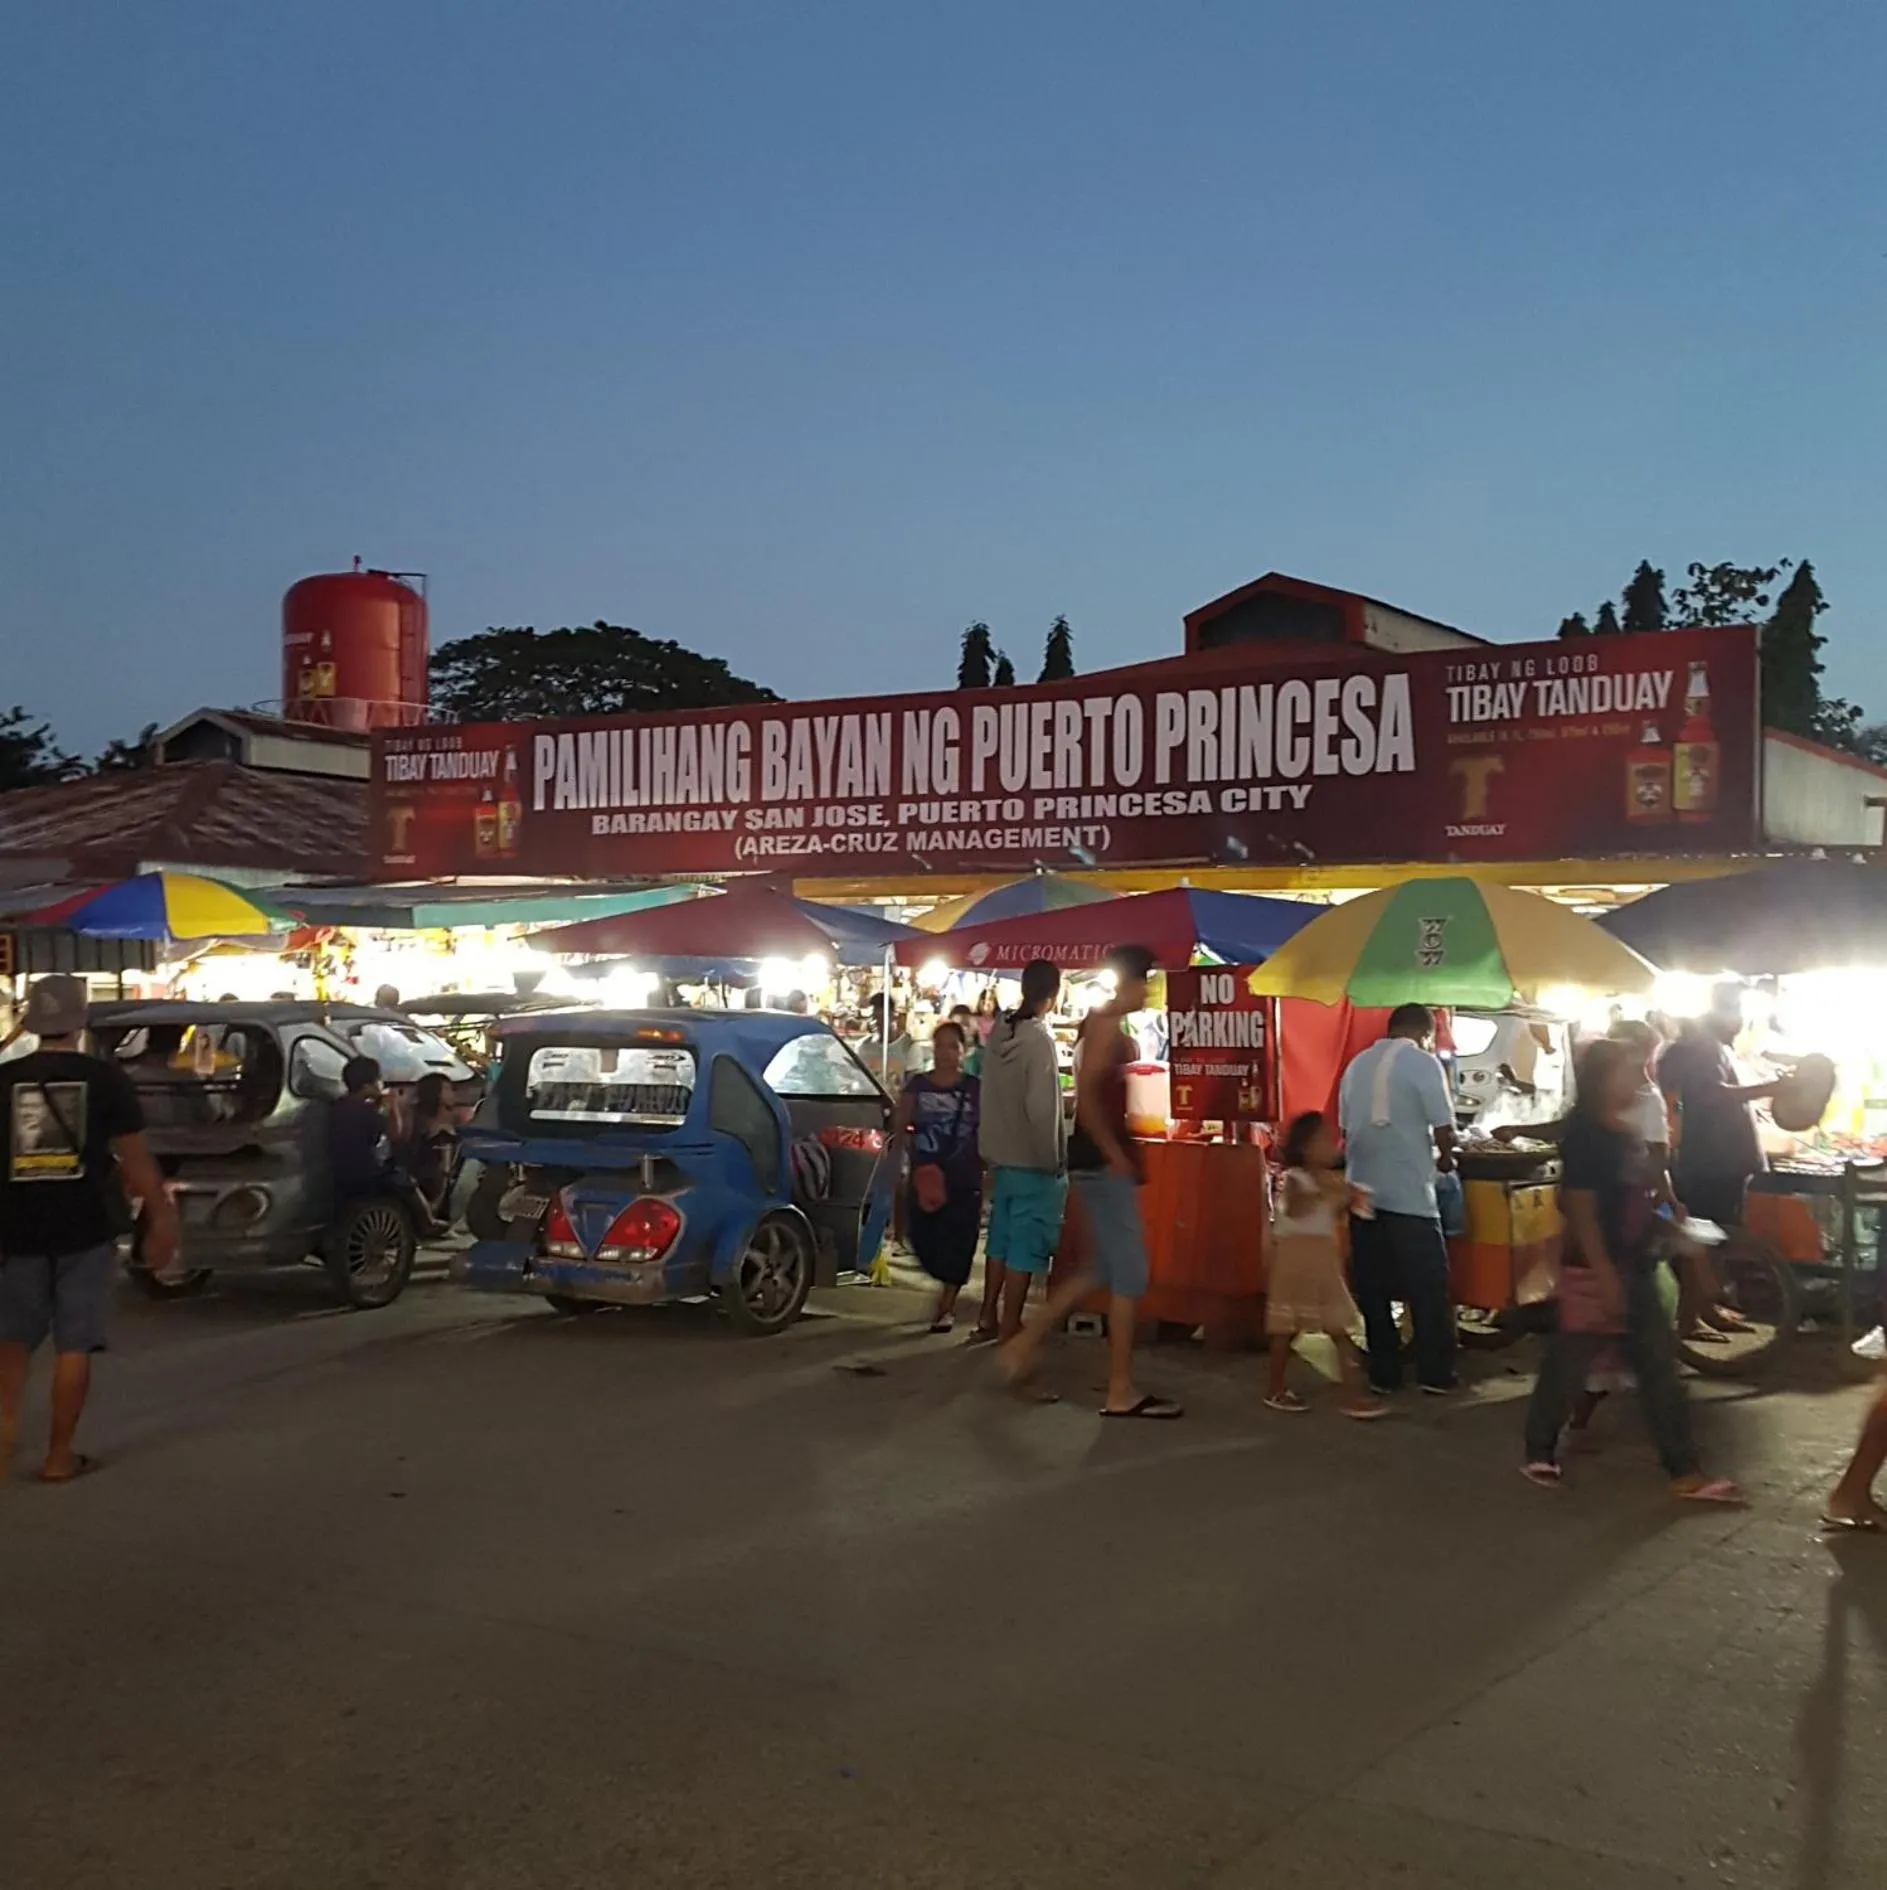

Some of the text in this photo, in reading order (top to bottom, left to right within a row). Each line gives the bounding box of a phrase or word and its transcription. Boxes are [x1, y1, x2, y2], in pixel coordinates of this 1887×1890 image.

[1445, 654, 1599, 682] TIBAY NG LOOB
[1446, 670, 1674, 722] TIBAY TANDUAY
[533, 673, 1415, 811] PAMILIHANG BAYAN NG PUERTO PRINCESA
[384, 750, 500, 782] TIBAY TANDUAY
[591, 784, 1313, 835] BARANGAY SAN JOSE, PUERTO PRINCESA CITY
[735, 824, 1111, 861] (AREZA-CRUZ MANAGEMENT)
[996, 943, 1116, 961] MICROMATIC
[1200, 973, 1235, 1005] NO
[1170, 1010, 1265, 1048] PARKING
